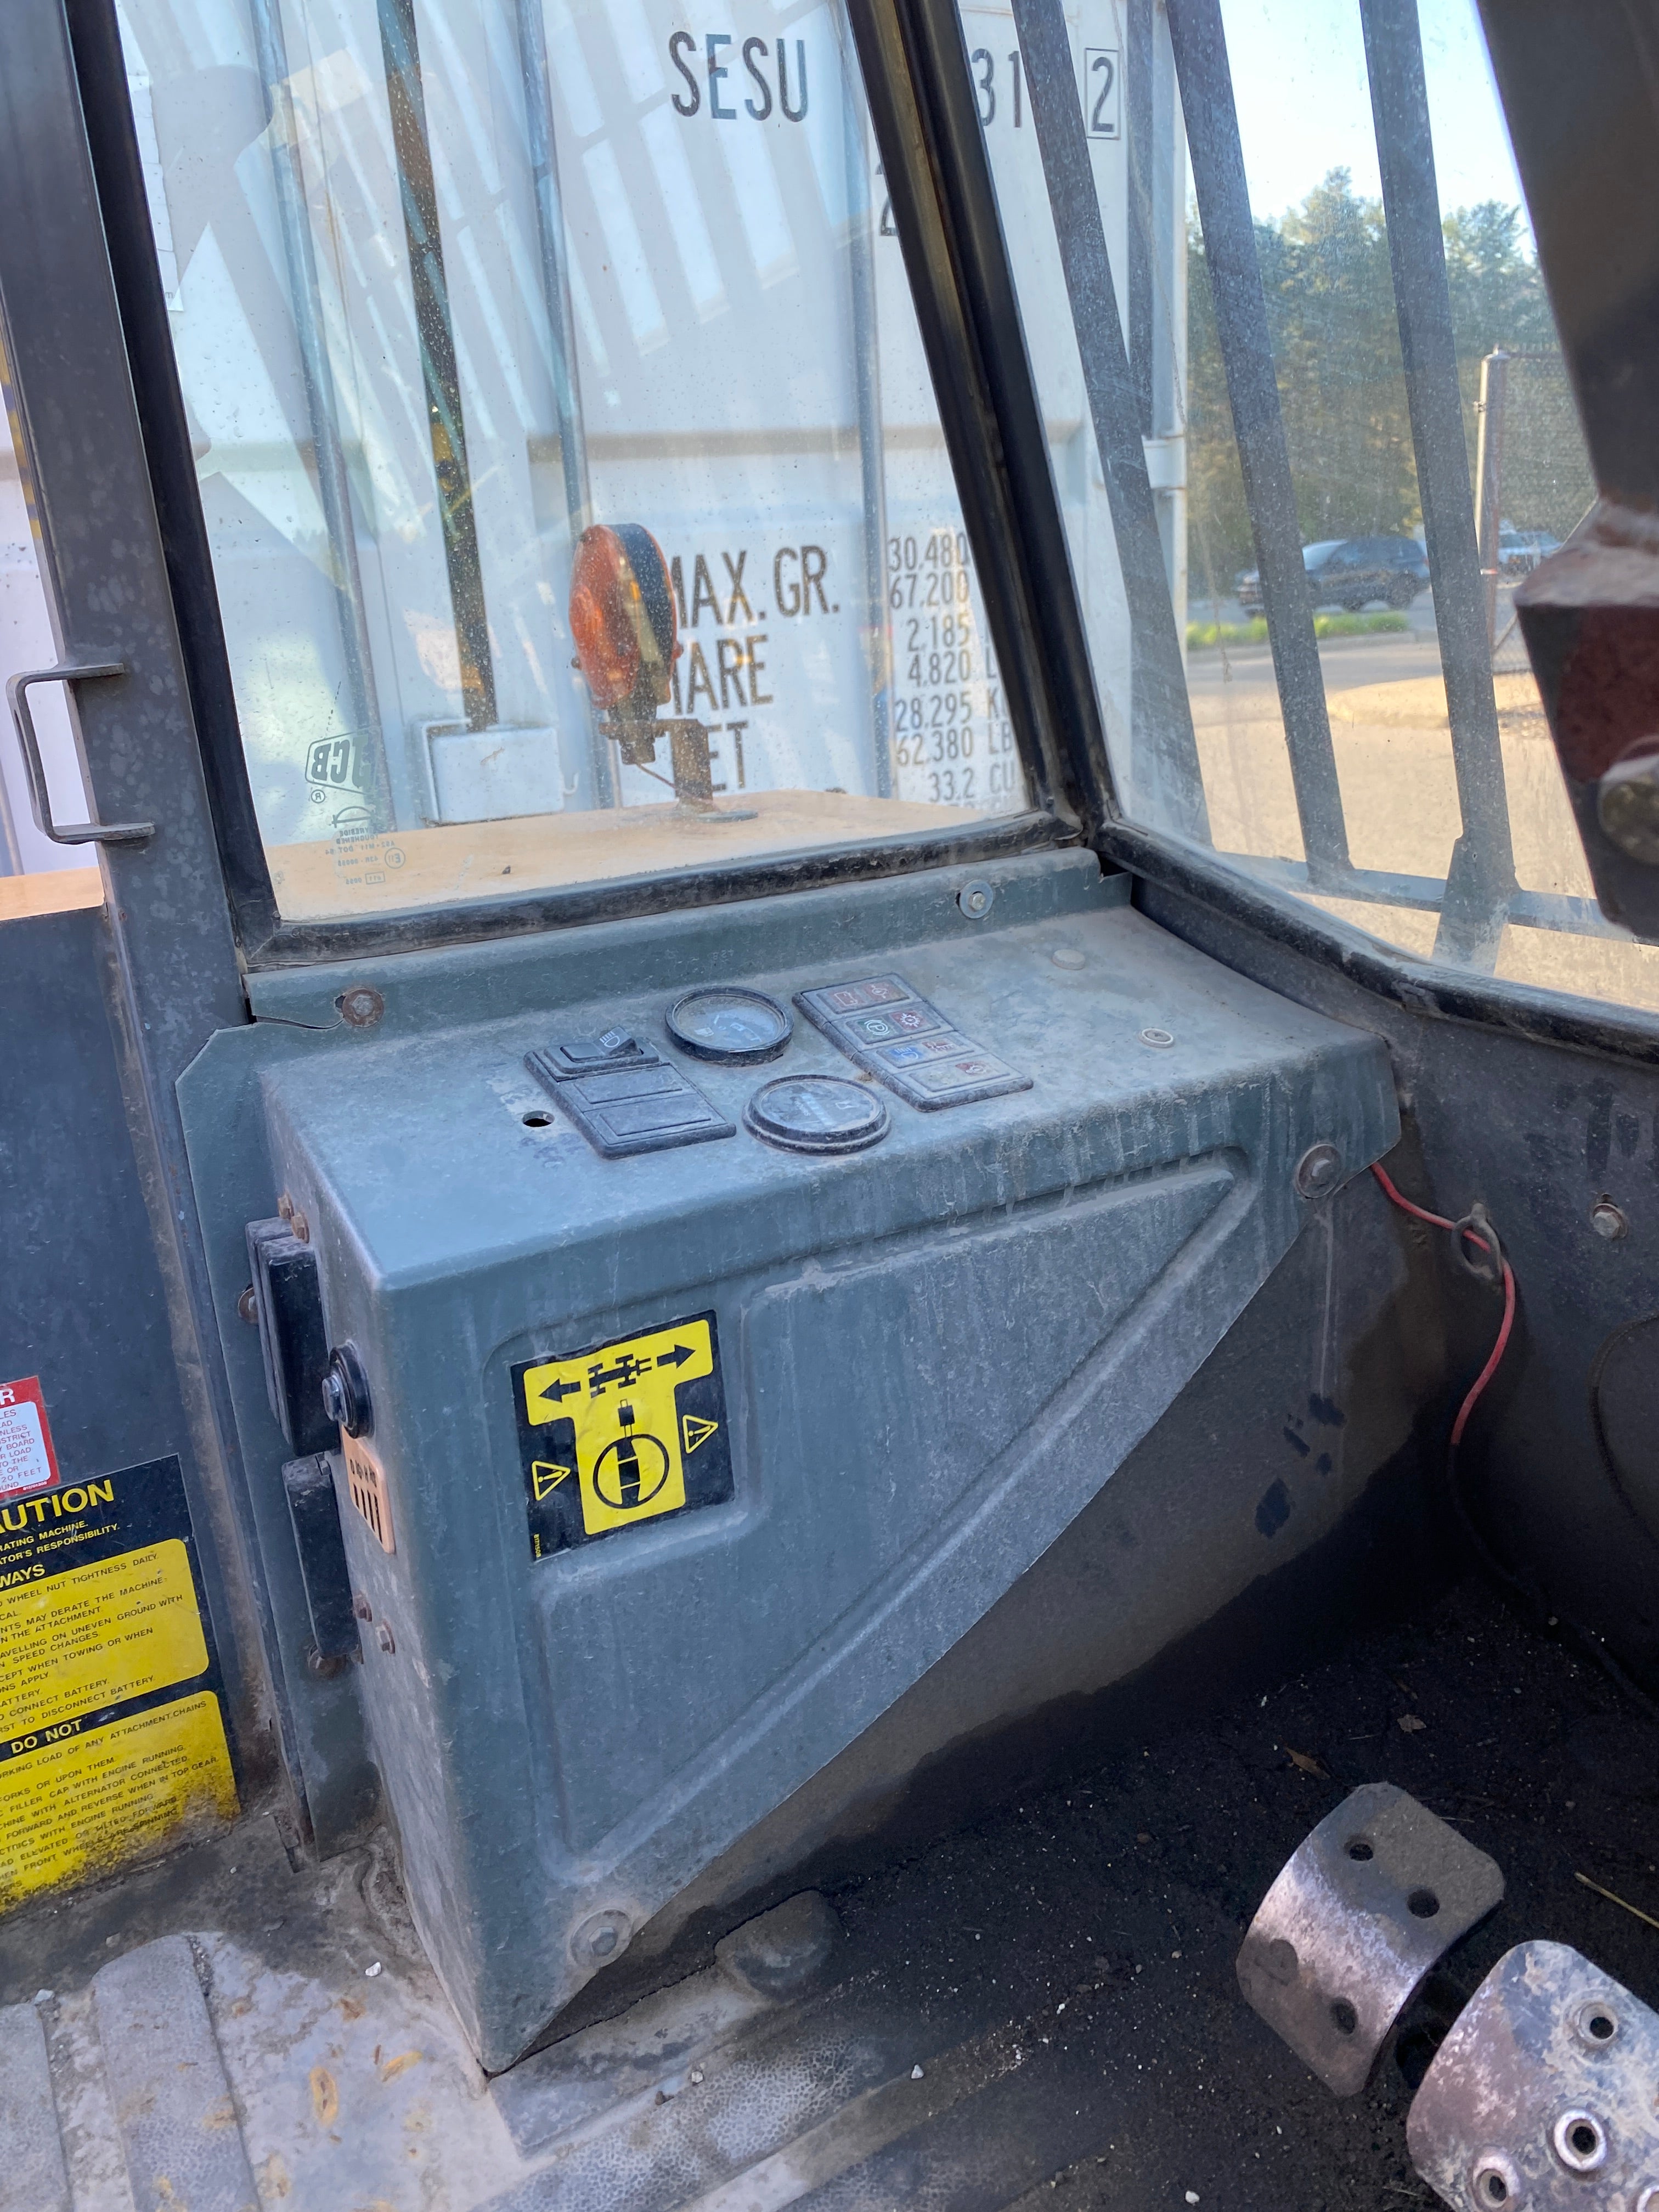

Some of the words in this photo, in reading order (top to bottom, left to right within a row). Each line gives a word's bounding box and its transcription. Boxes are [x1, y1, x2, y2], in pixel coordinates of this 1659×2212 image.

[669, 31, 808, 123] SESU
[1092, 57, 1114, 132] 2
[774, 545, 840, 617] GR.
[7, 1438, 35, 1450] BOARD
[9, 1447, 31, 1458] LOAD
[12, 1455, 29, 1464] THE
[18, 1466, 42, 1479] FEET
[36, 1523, 120, 1554] RESPONSIBILITY.
[39, 1521, 88, 1540] MACHINE.
[7, 1589, 42, 1604] WHEEL
[47, 1581, 66, 1592] NUT
[71, 1562, 127, 1585] TIGHTNESS
[26, 1613, 47, 1626] MAY
[51, 1600, 90, 1617] DERATE
[95, 1592, 115, 1603] THE
[52, 1632, 67, 1641] ON
[71, 1617, 112, 1635] UNEVEN
[117, 1603, 156, 1621] GROUND
[159, 1594, 183, 1607] WITH
[11, 1629, 31, 1640] THE
[28, 1657, 59, 1673] WHEN
[63, 1643, 103, 1661] TOWING
[108, 1638, 122, 1647] OR
[125, 1627, 154, 1641] WHEN
[13, 1649, 46, 1664] SPEED
[9, 1695, 59, 1717] CONNECT
[21, 1716, 35, 1725] TO
[42, 1691, 106, 1719] DISCONNECT
[11, 1736, 38, 1754] DO
[45, 1719, 82, 1742] NOT
[37, 1752, 63, 1766] LOAD
[67, 1745, 81, 1754] OF
[85, 1736, 104, 1749] ANY
[173, 1700, 207, 1717] CHAINS
[9, 1796, 43, 1813] FILLER
[49, 1786, 69, 1798] CAP
[72, 1775, 98, 1789] WITH
[102, 1761, 137, 1779] ENGINE
[36, 1780, 50, 1790] OR
[55, 1768, 82, 1784] UPON
[6, 1818, 53, 1840] FORWARD
[58, 1808, 77, 1821] AND
[81, 1791, 124, 1812] REVERSE
[127, 1779, 156, 1794] WHEN
[171, 1767, 189, 1778] TOP
[31, 1803, 57, 1818] WITH
[64, 1778, 126, 1806] ALTERNATOR
[40, 1825, 66, 1840] WITH
[71, 1810, 106, 1829] ENGINE
[20, 1837, 69, 1861] ELEVATED
[24, 1853, 57, 1871] FRONT
